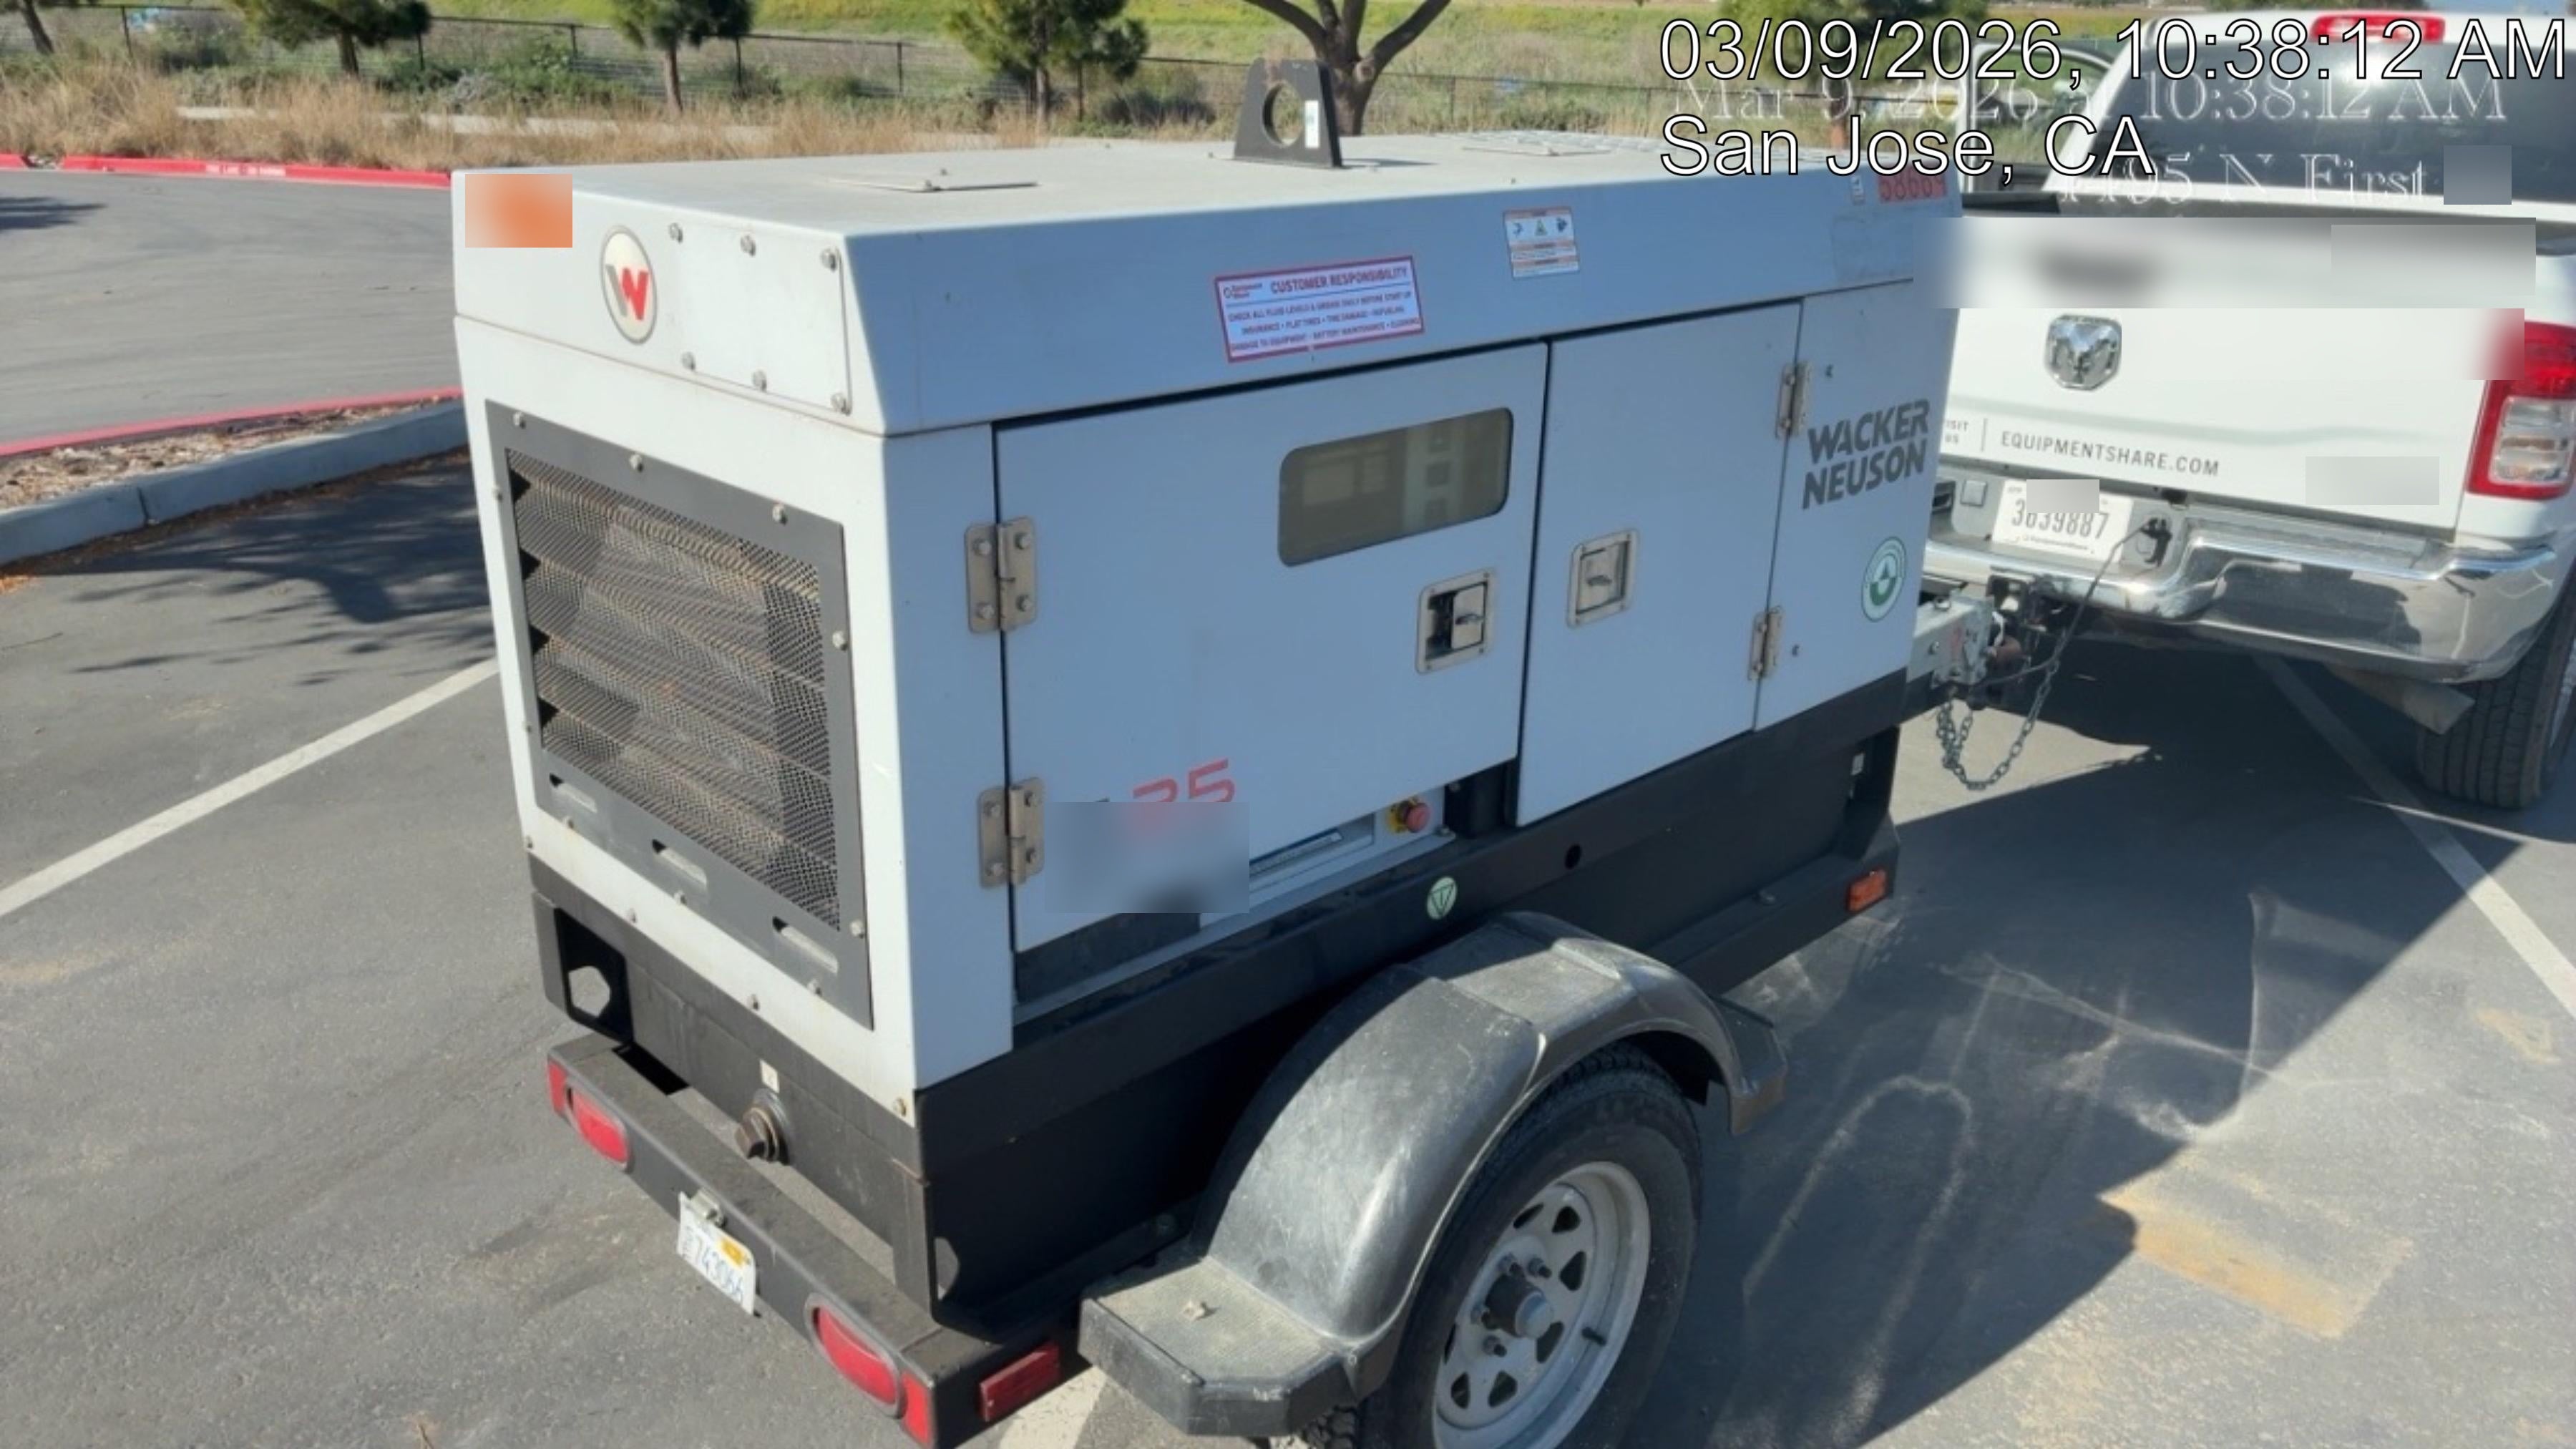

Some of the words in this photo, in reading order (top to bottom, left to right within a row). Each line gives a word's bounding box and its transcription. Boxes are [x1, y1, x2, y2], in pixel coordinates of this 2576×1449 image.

[1271, 275, 1327, 294] CUSTOMER
[1330, 266, 1407, 286] RESPONSIBILITY
[1807, 399, 1930, 464] WACKER
[2001, 430, 2220, 477] EQUIPMENTSHARE.COM
[1802, 439, 1928, 509] NEUSON
